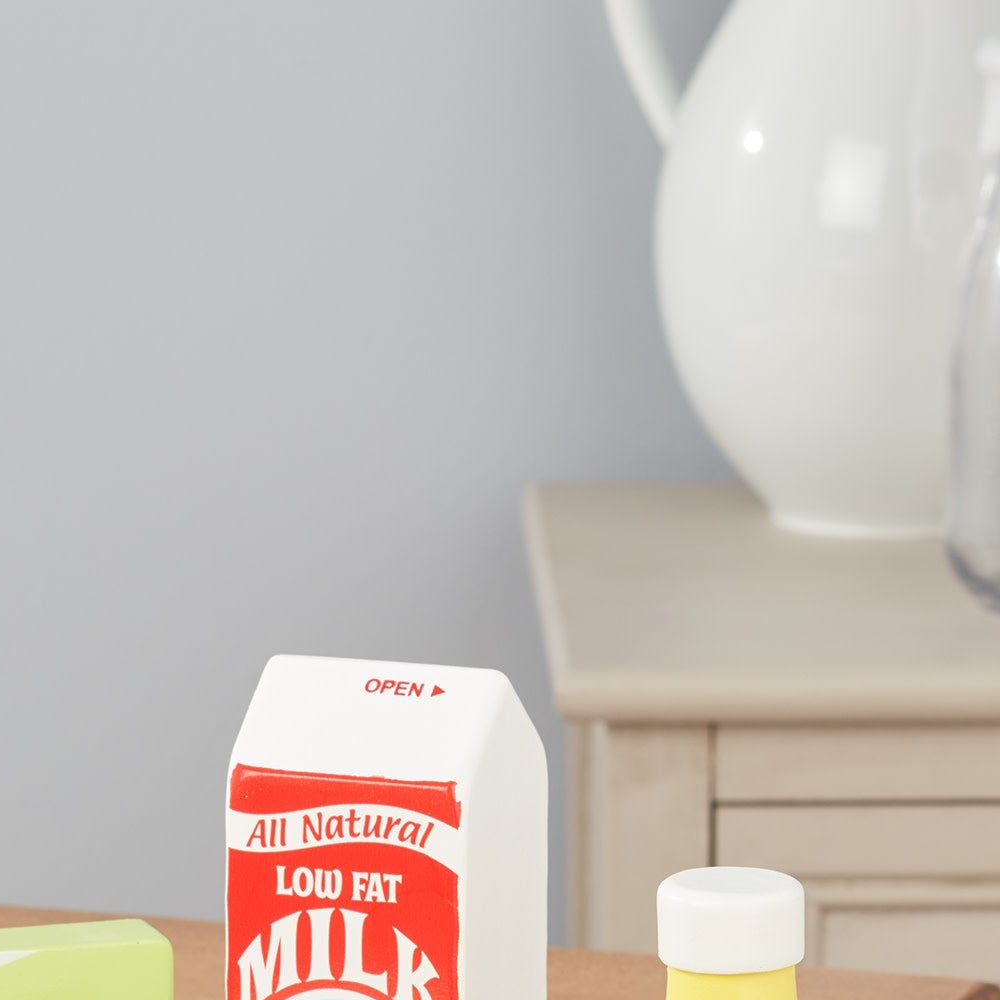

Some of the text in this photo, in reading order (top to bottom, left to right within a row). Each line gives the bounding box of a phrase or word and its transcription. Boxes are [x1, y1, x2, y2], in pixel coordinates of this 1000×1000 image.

[364, 678, 425, 697] OPEN
[246, 808, 434, 849] All Natural
[275, 865, 402, 904] LOW FAT
